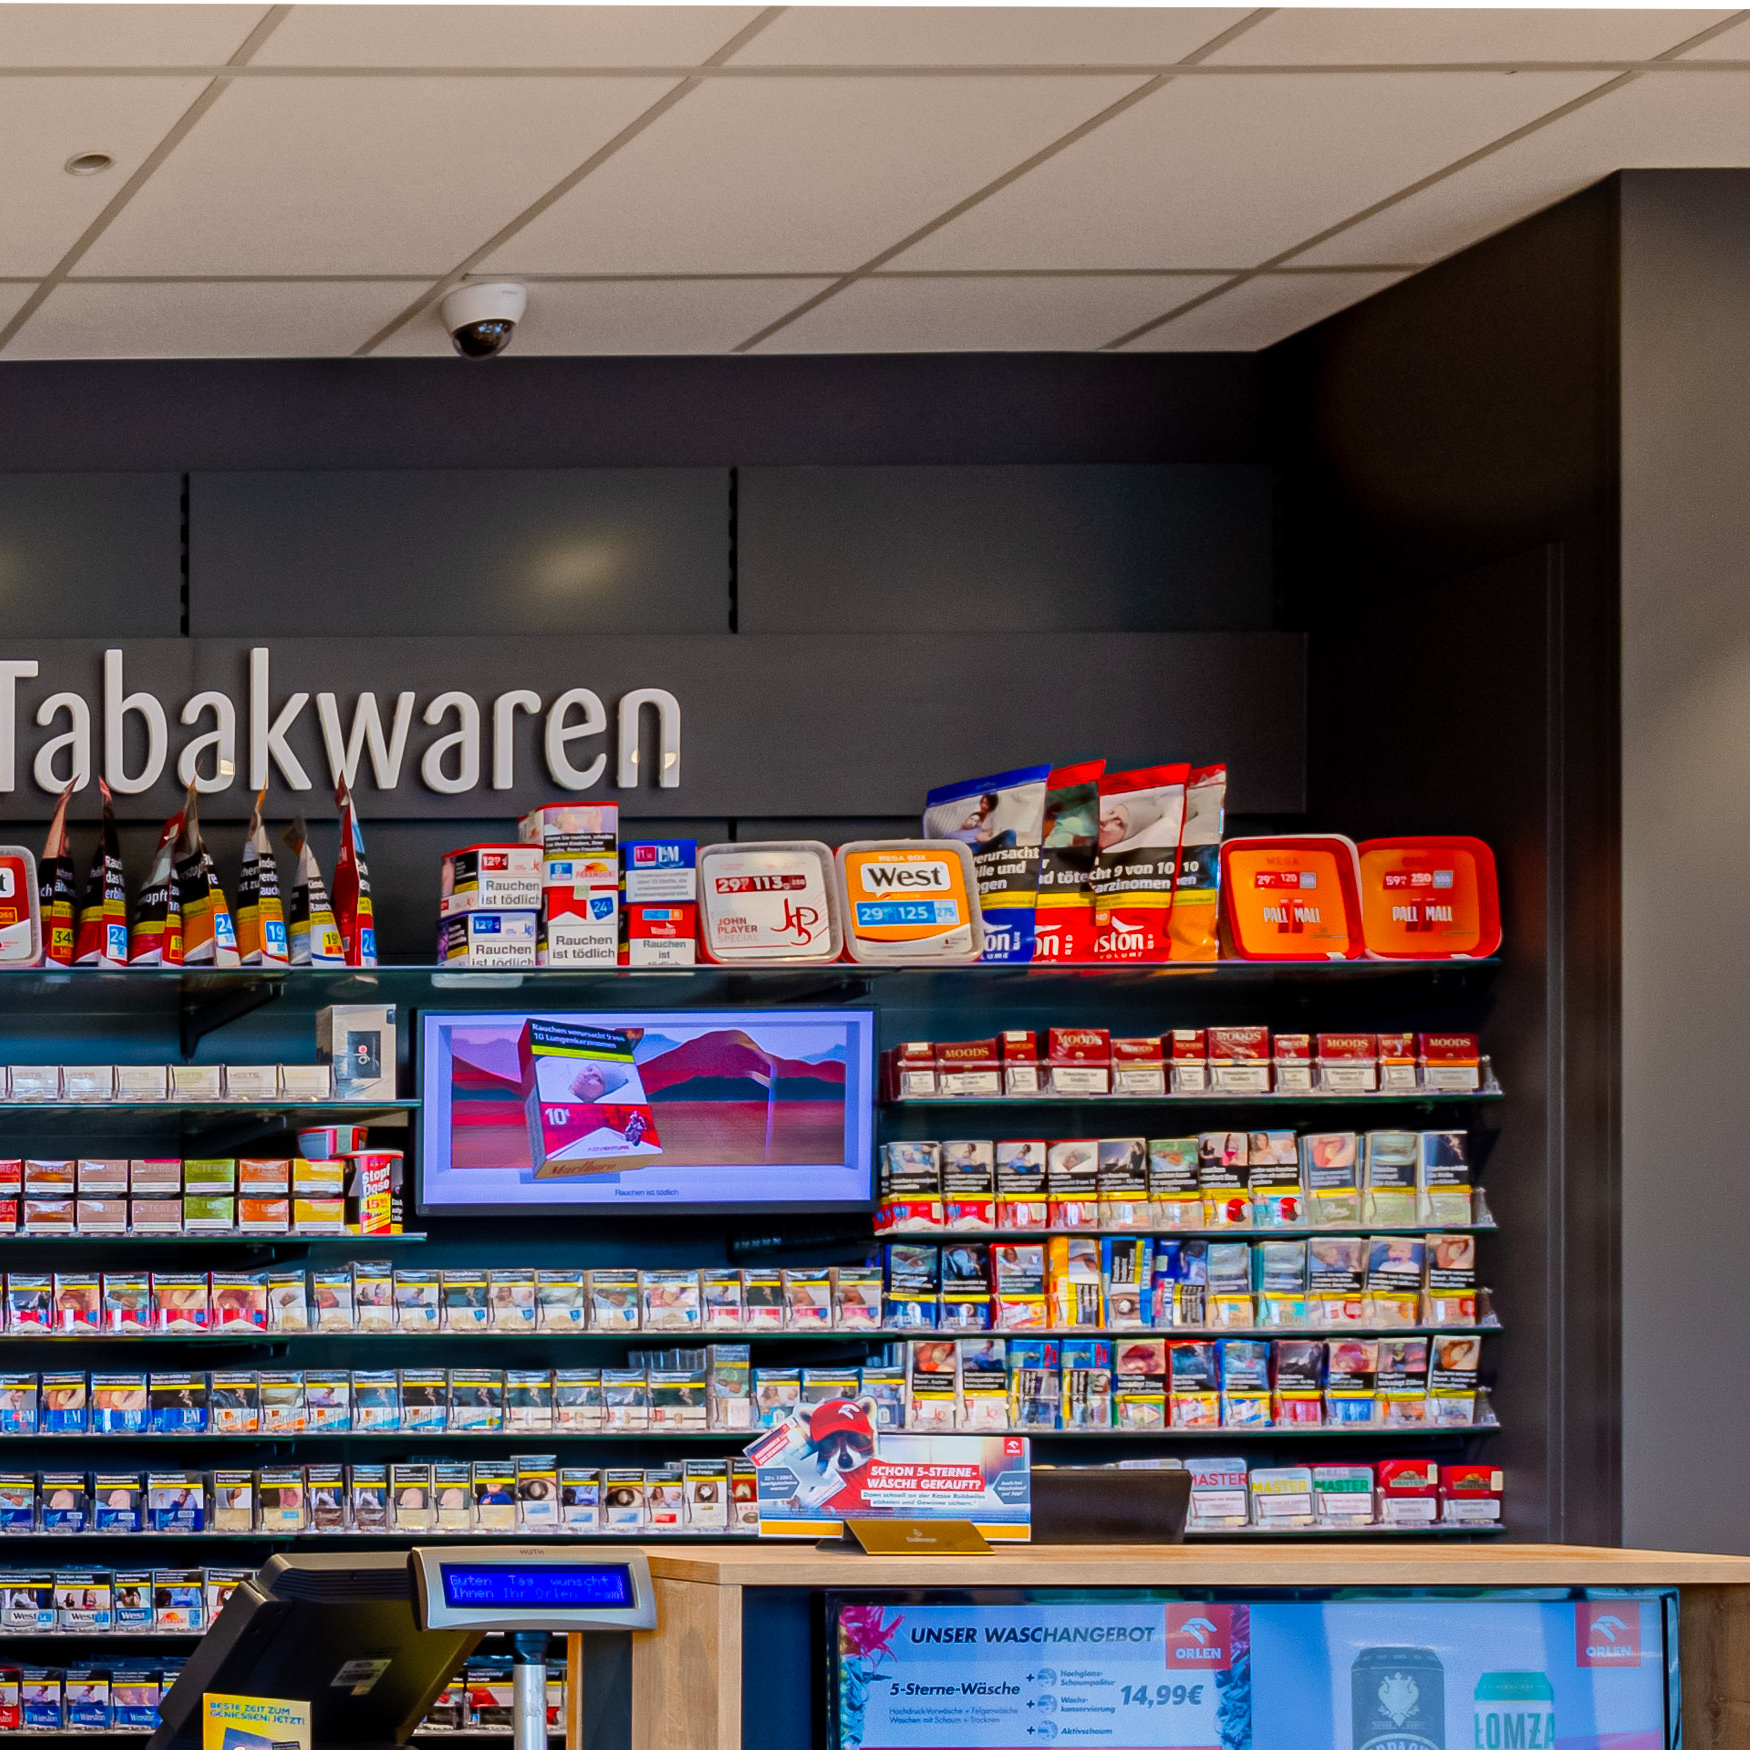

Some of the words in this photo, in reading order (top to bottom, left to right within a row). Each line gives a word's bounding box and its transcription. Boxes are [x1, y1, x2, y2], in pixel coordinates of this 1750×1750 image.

[867, 864, 943, 887] West
[717, 917, 743, 926] JOHN
[717, 925, 758, 935] PLAYER
[554, 935, 613, 948] Rauchen
[552, 947, 570, 959] ist
[574, 946, 615, 960] tödlich
[871, 1466, 914, 1477] SCHON
[867, 1476, 918, 1489] WÄSCHE
[920, 1478, 981, 1490] GEKAUFT?
[910, 1627, 978, 1644] UNSER
[984, 1626, 1155, 1643] WASCHANGEBOT
[1175, 1648, 1221, 1660] ORLEN
[1586, 1646, 1631, 1658] ORLEN
[889, 1682, 1020, 1696] 5-Sterne-Wäsche
[1120, 1684, 1204, 1708] 14,99€
